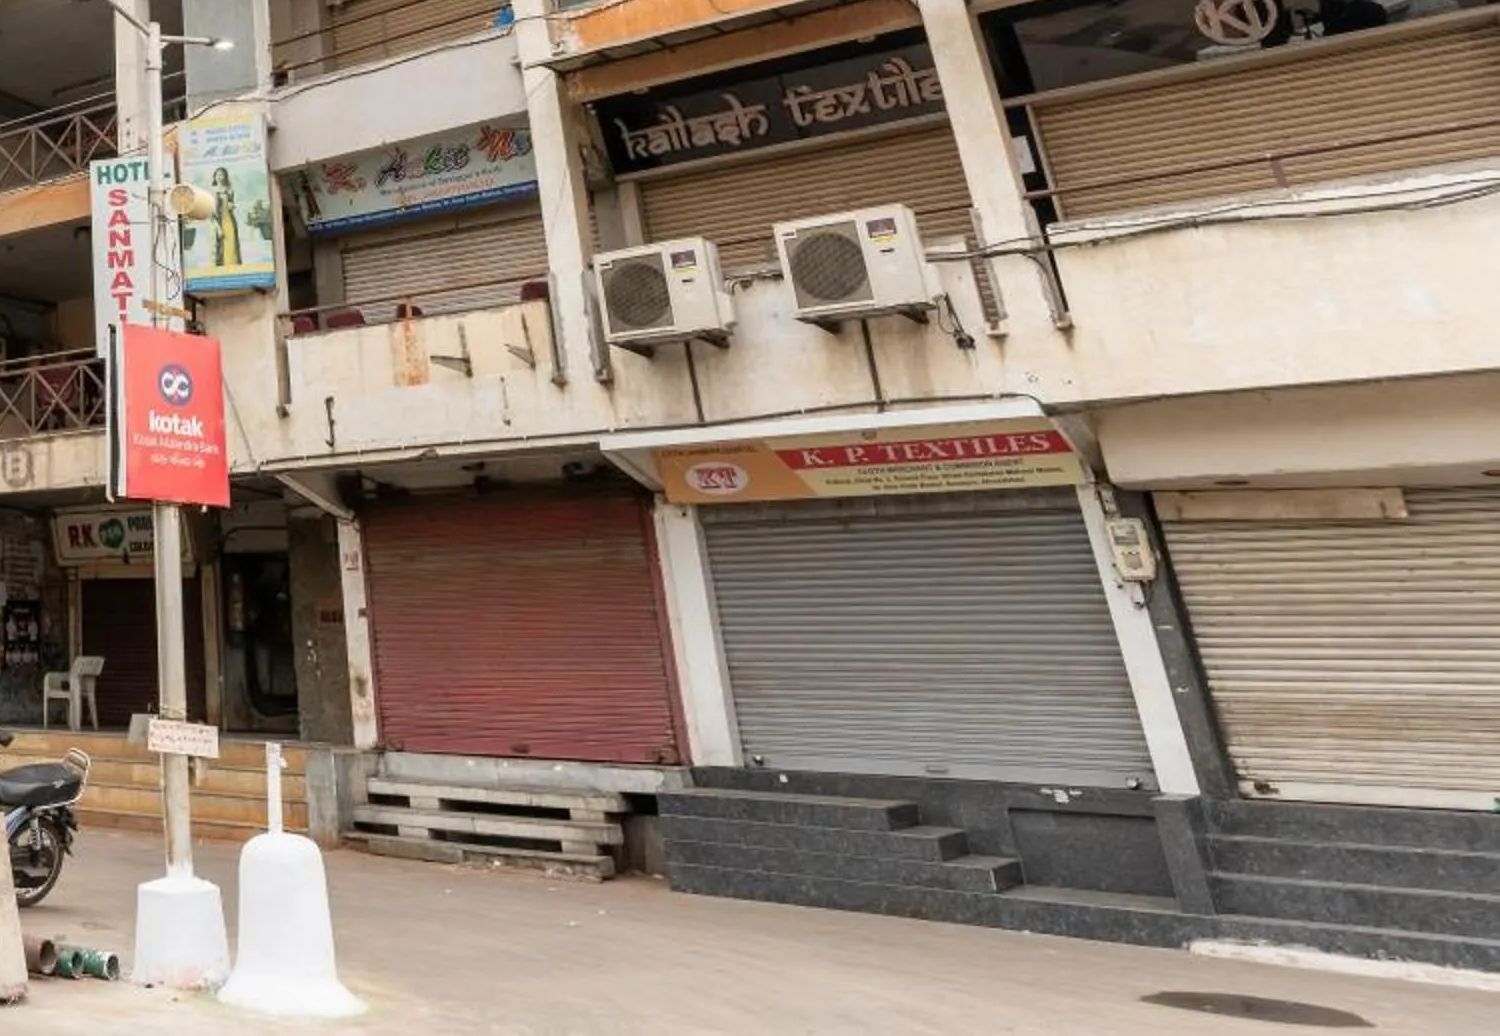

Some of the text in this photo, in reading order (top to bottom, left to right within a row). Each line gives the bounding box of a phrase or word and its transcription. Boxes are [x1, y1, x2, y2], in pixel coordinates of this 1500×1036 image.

[614, 94, 769, 161] kailash
[97, 160, 171, 185] HOT
[107, 189, 134, 321] SANMAT
[148, 410, 205, 437] kotak
[802, 433, 1051, 466] K. P. TEXTILES
[696, 467, 738, 490] KT
